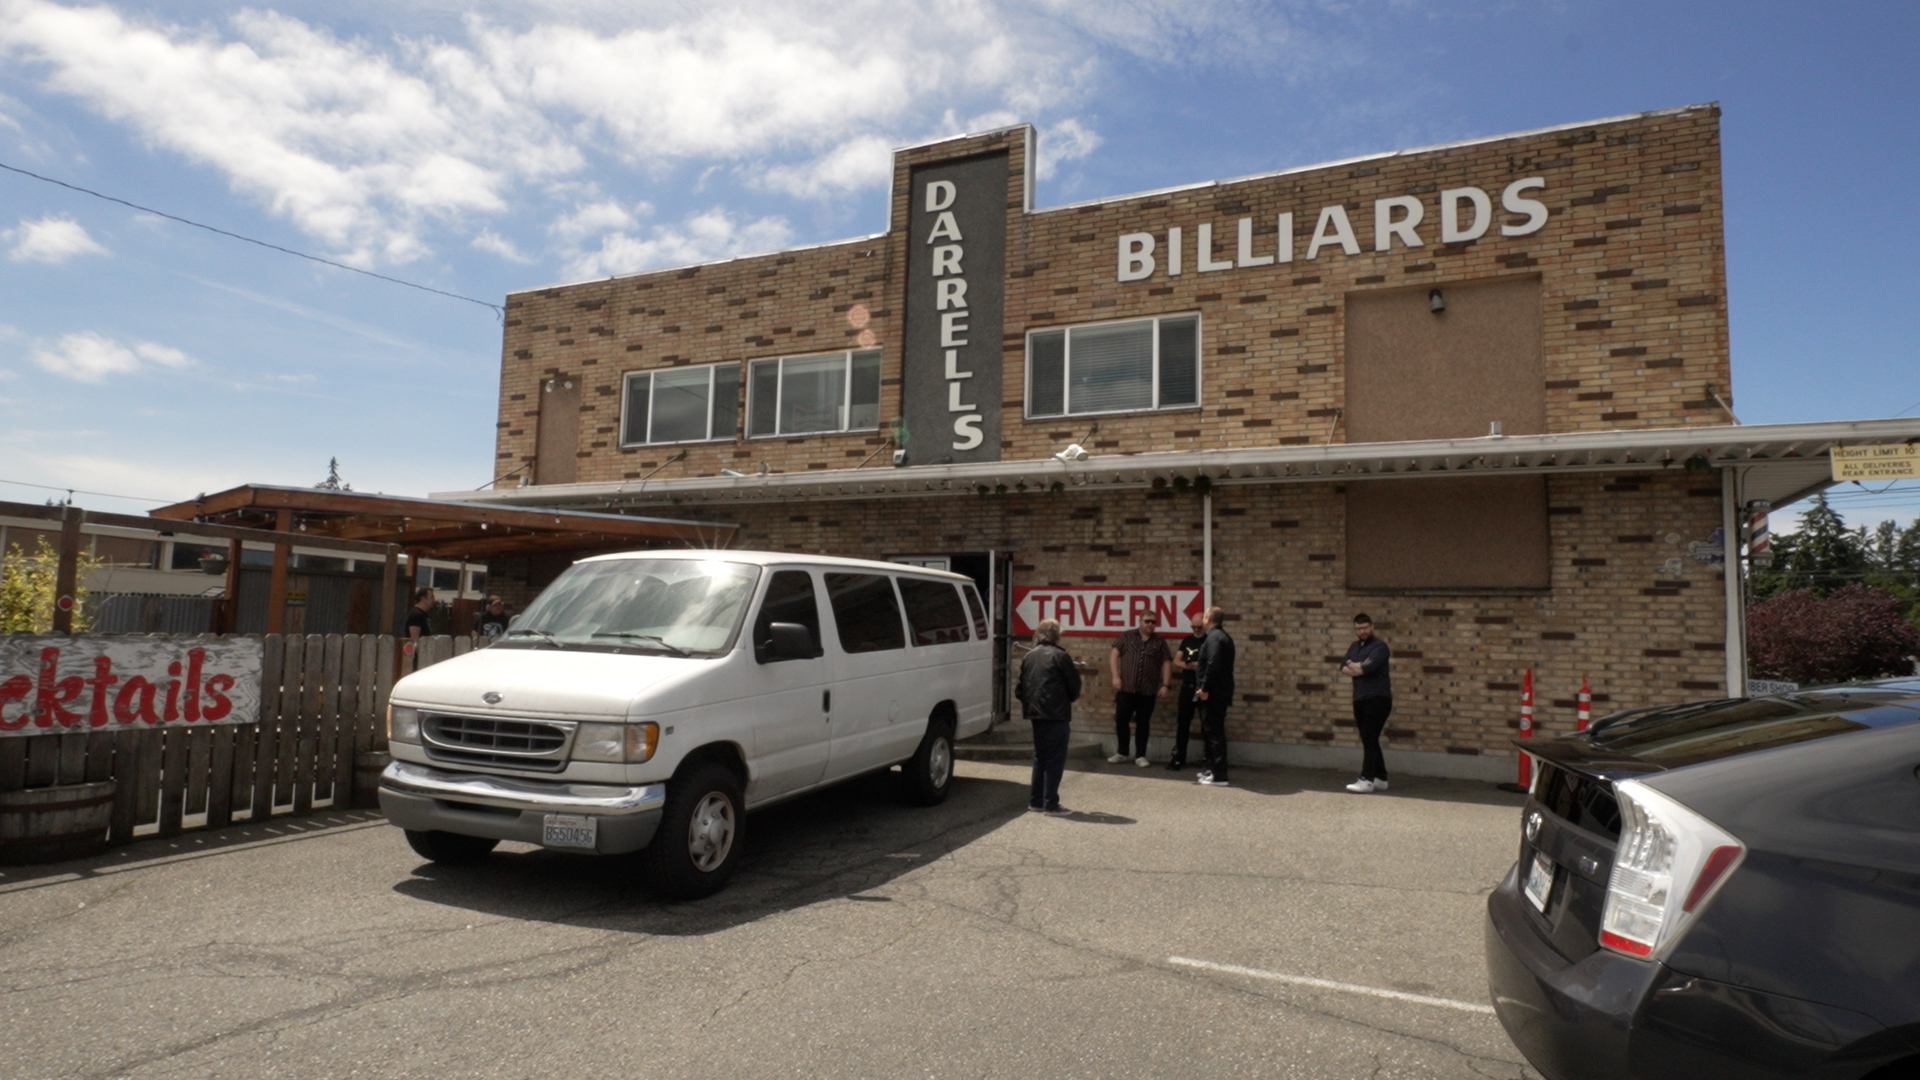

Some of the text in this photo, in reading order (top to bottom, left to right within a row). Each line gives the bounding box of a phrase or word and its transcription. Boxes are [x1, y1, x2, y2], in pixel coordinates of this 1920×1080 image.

[1118, 176, 1549, 282] BILLIARDS
[925, 180, 984, 450] DARRELLS
[1833, 449, 1868, 458] HEIGHT
[1873, 448, 1899, 456] LIMIT
[1863, 461, 1912, 469] DELIVERIES
[1869, 468, 1915, 476] ENTRANCE
[1031, 595, 1177, 628] TAVERN
[0, 647, 235, 731] cktails
